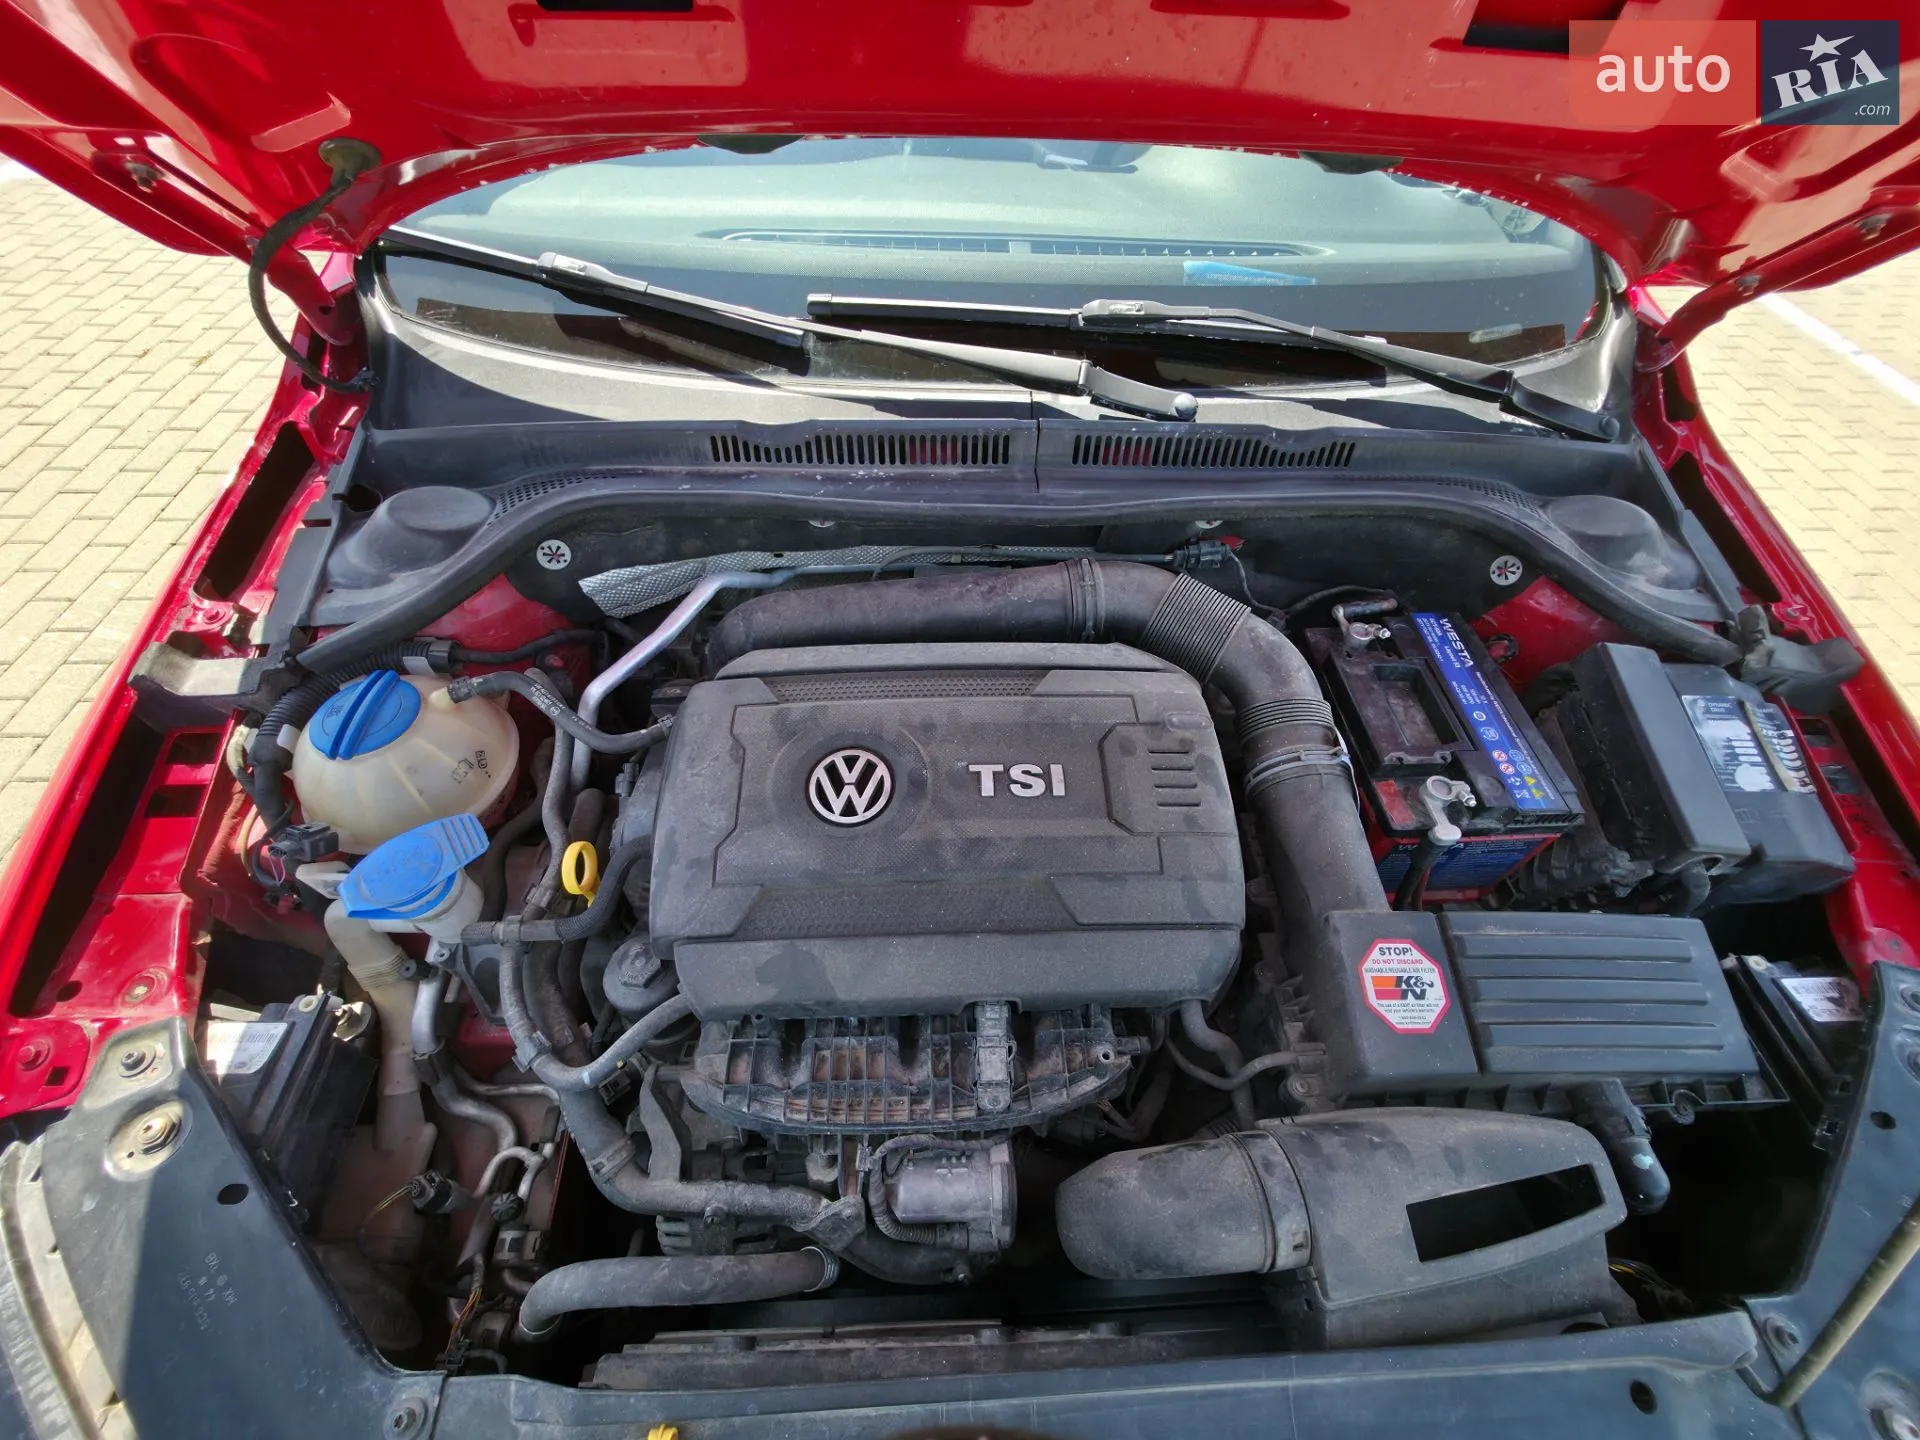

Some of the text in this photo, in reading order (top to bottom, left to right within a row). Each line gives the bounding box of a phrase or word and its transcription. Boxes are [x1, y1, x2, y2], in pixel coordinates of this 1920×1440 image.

[1440, 618, 1474, 668] WESTA
[809, 749, 892, 824] VW
[968, 763, 1066, 798] TSI
[1378, 946, 1414, 957] STOP!
[1395, 975, 1435, 1001] K&N
